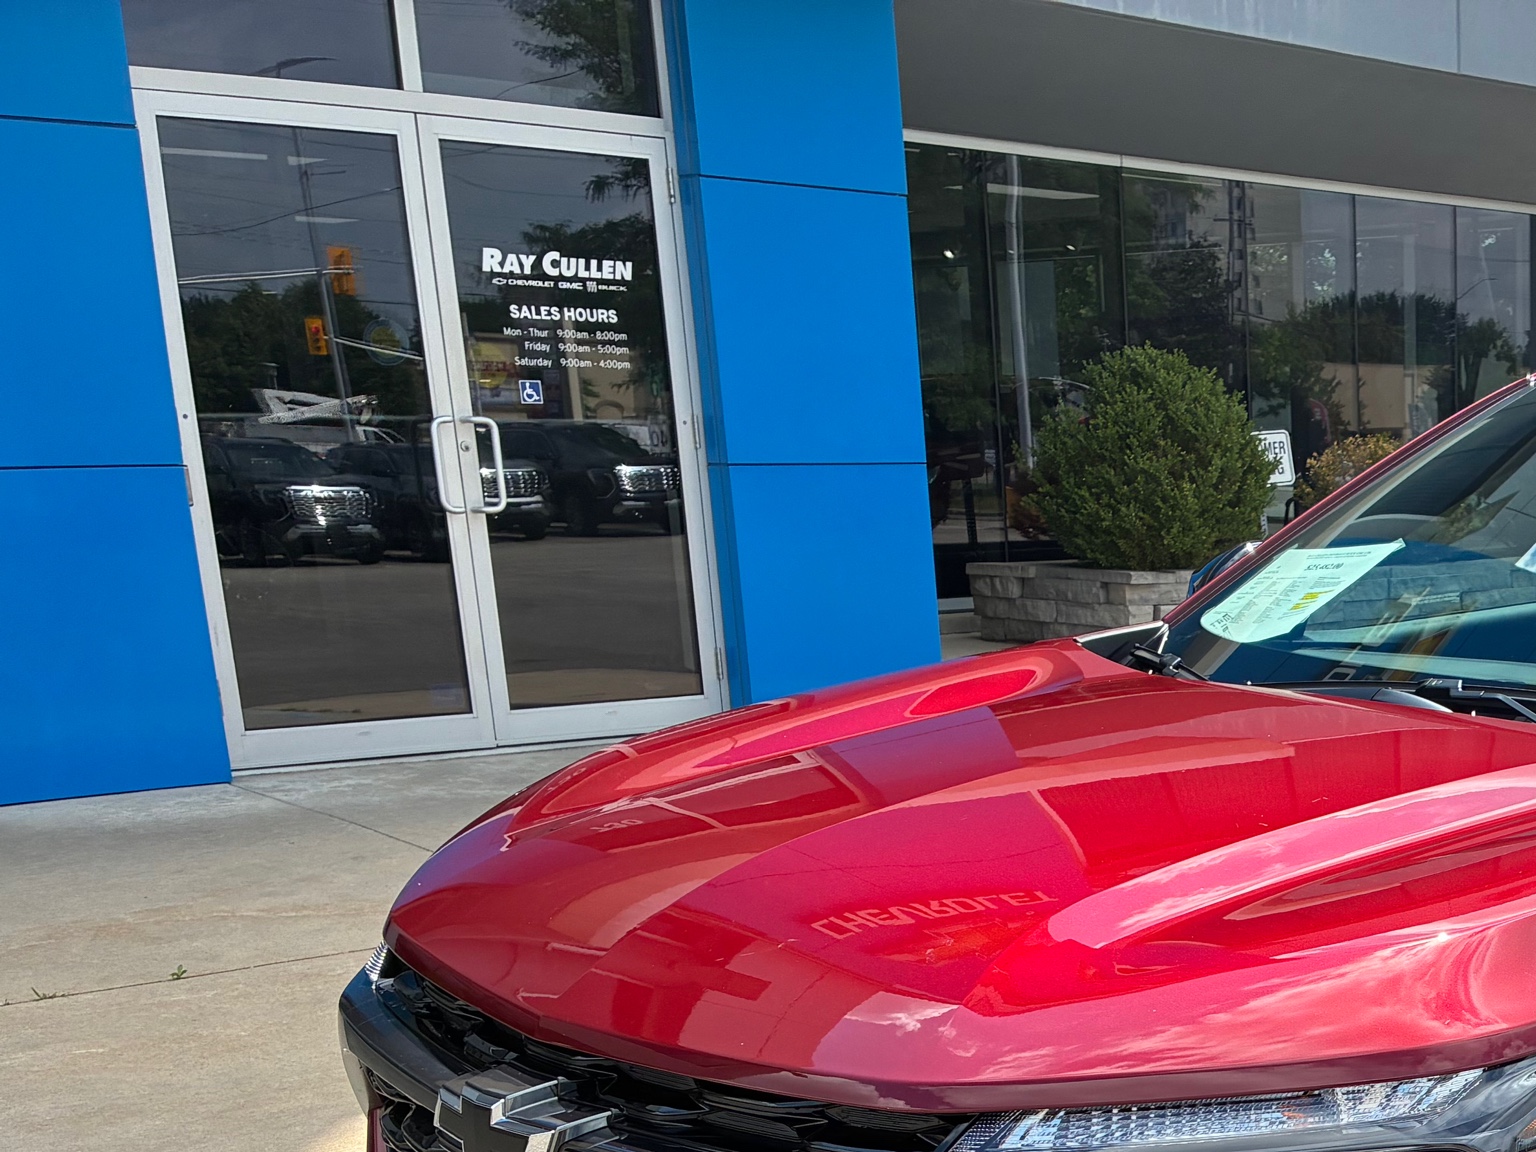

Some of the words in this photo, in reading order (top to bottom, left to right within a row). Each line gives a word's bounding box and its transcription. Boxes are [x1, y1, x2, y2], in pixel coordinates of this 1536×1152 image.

[482, 247, 537, 275] RAY
[542, 251, 633, 281] CULLEN
[508, 279, 555, 288] CHEVROLET
[558, 282, 584, 290] GMC
[509, 304, 561, 320] SALES
[564, 307, 619, 323] HOURS
[503, 327, 522, 336] Mon
[529, 329, 549, 337] Thur
[556, 329, 589, 339] 9:00am
[596, 331, 628, 341] 8:00pm
[524, 341, 550, 353] Friday
[558, 343, 590, 353] 9:00am
[597, 345, 630, 354] 5:00pm
[514, 356, 552, 368] Saturday
[560, 358, 592, 367] 9:00am
[599, 360, 631, 370] 4:00pm
